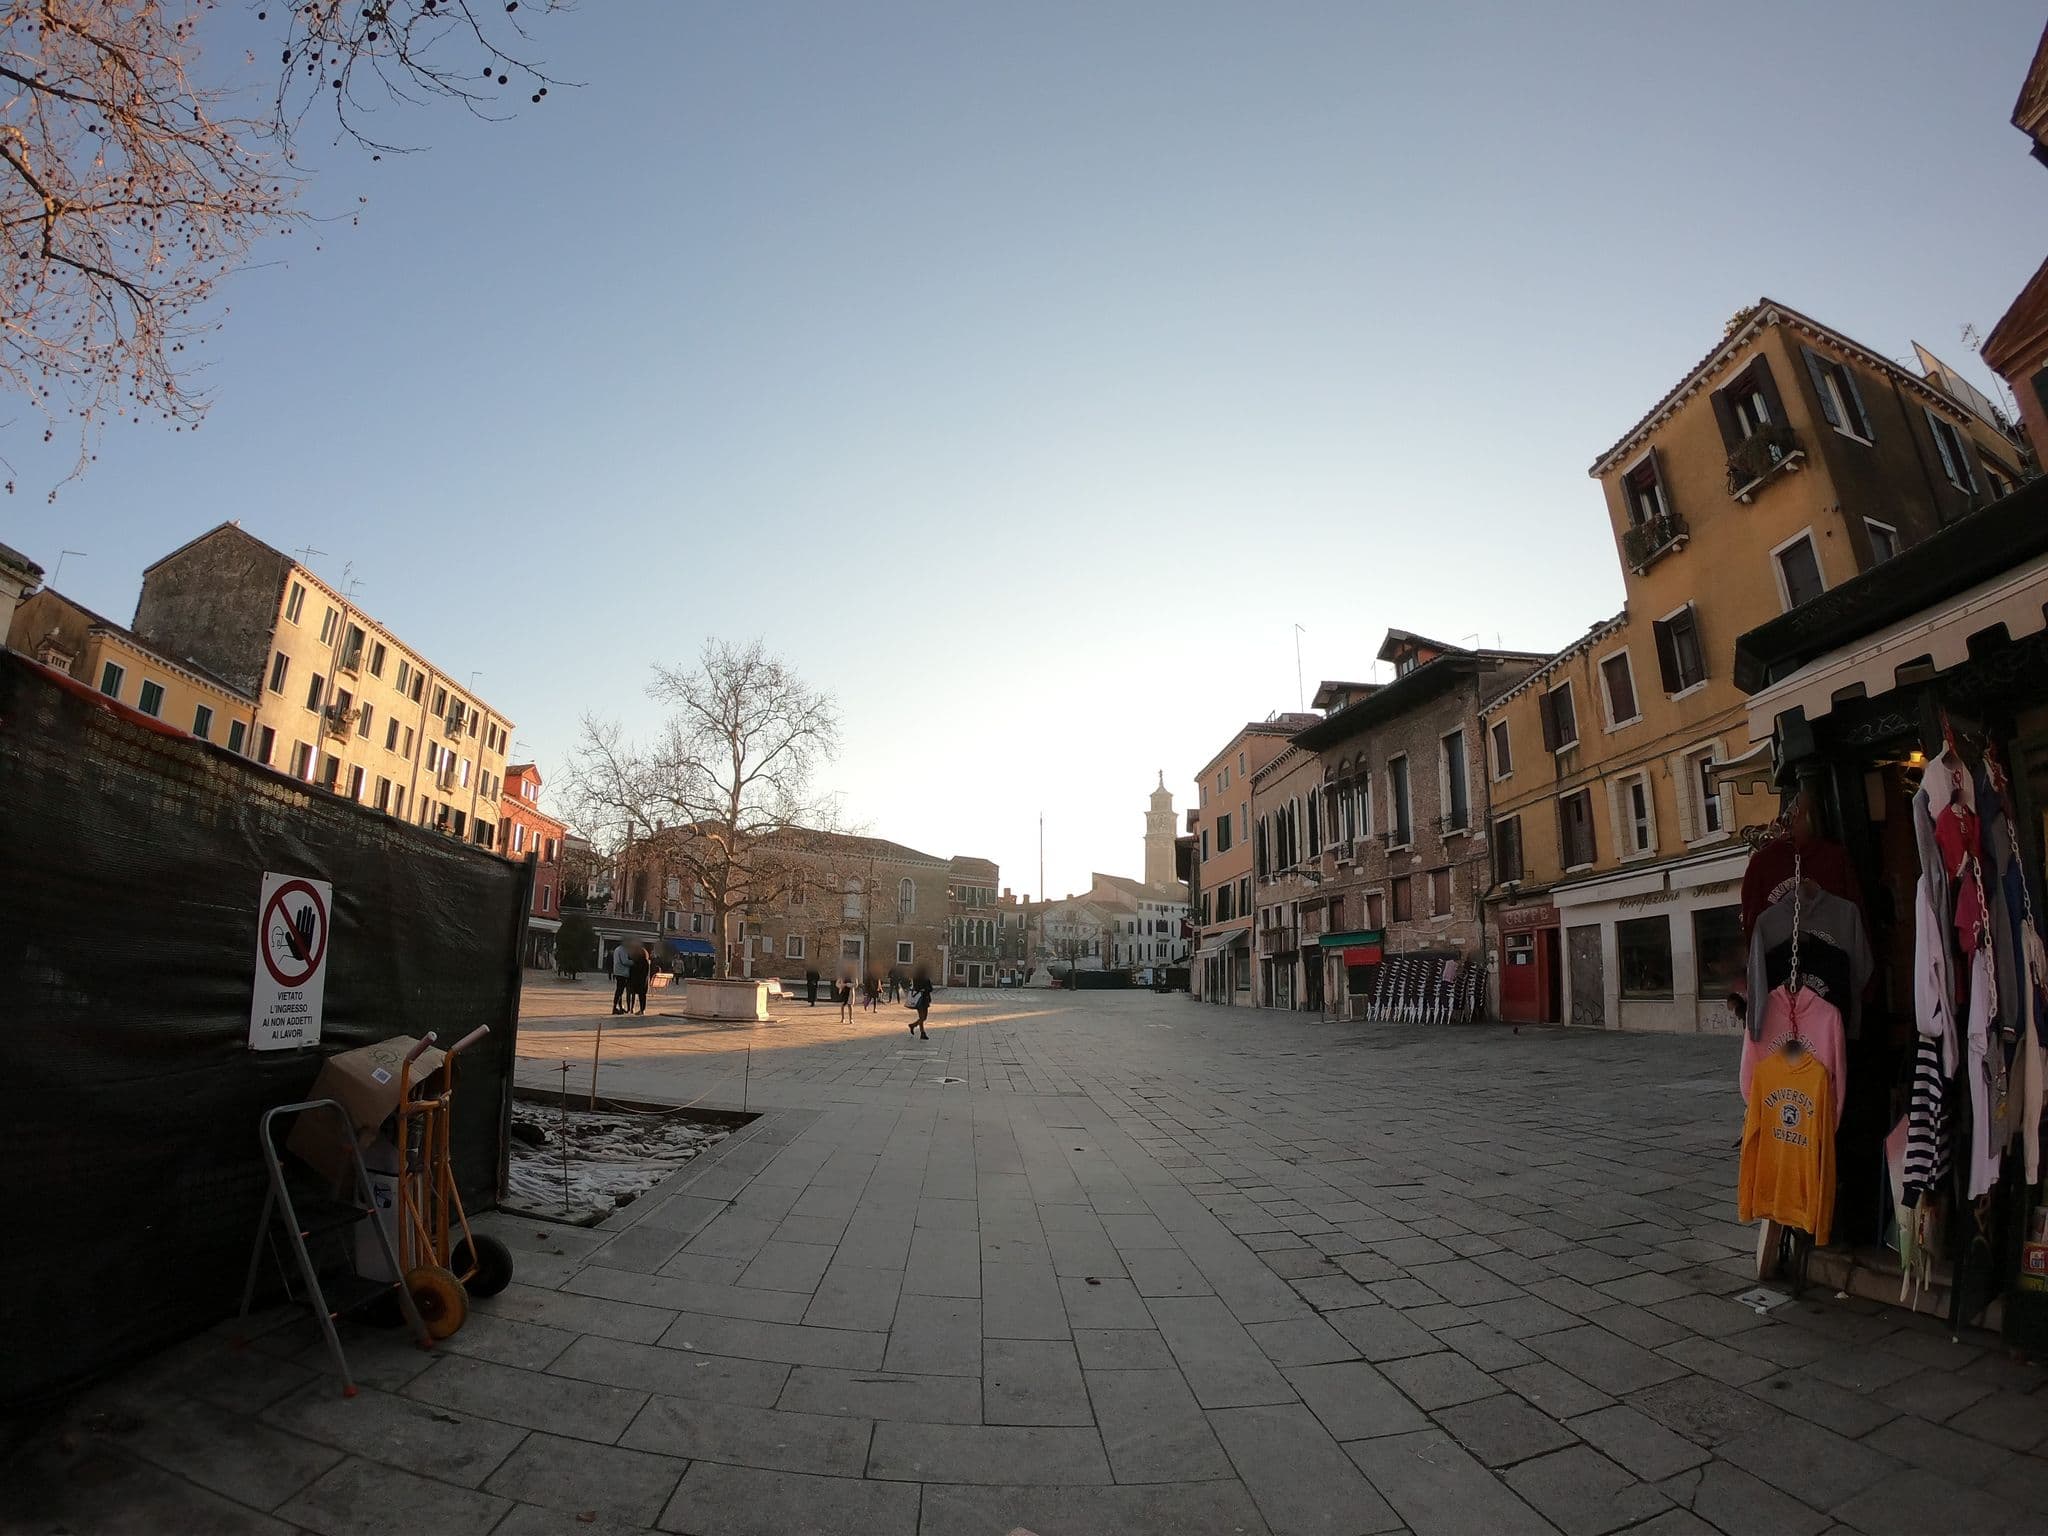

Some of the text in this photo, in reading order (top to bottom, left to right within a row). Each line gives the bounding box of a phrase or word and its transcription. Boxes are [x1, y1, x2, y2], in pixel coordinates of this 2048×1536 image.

[277, 991, 304, 1001] VIETATO
[270, 1003, 308, 1014] L'INGRESSO
[262, 1015, 313, 1027] AI NON ADDETTI
[272, 1028, 303, 1039] AI LAVORI
[1772, 1127, 1809, 1147] VENEZIA
